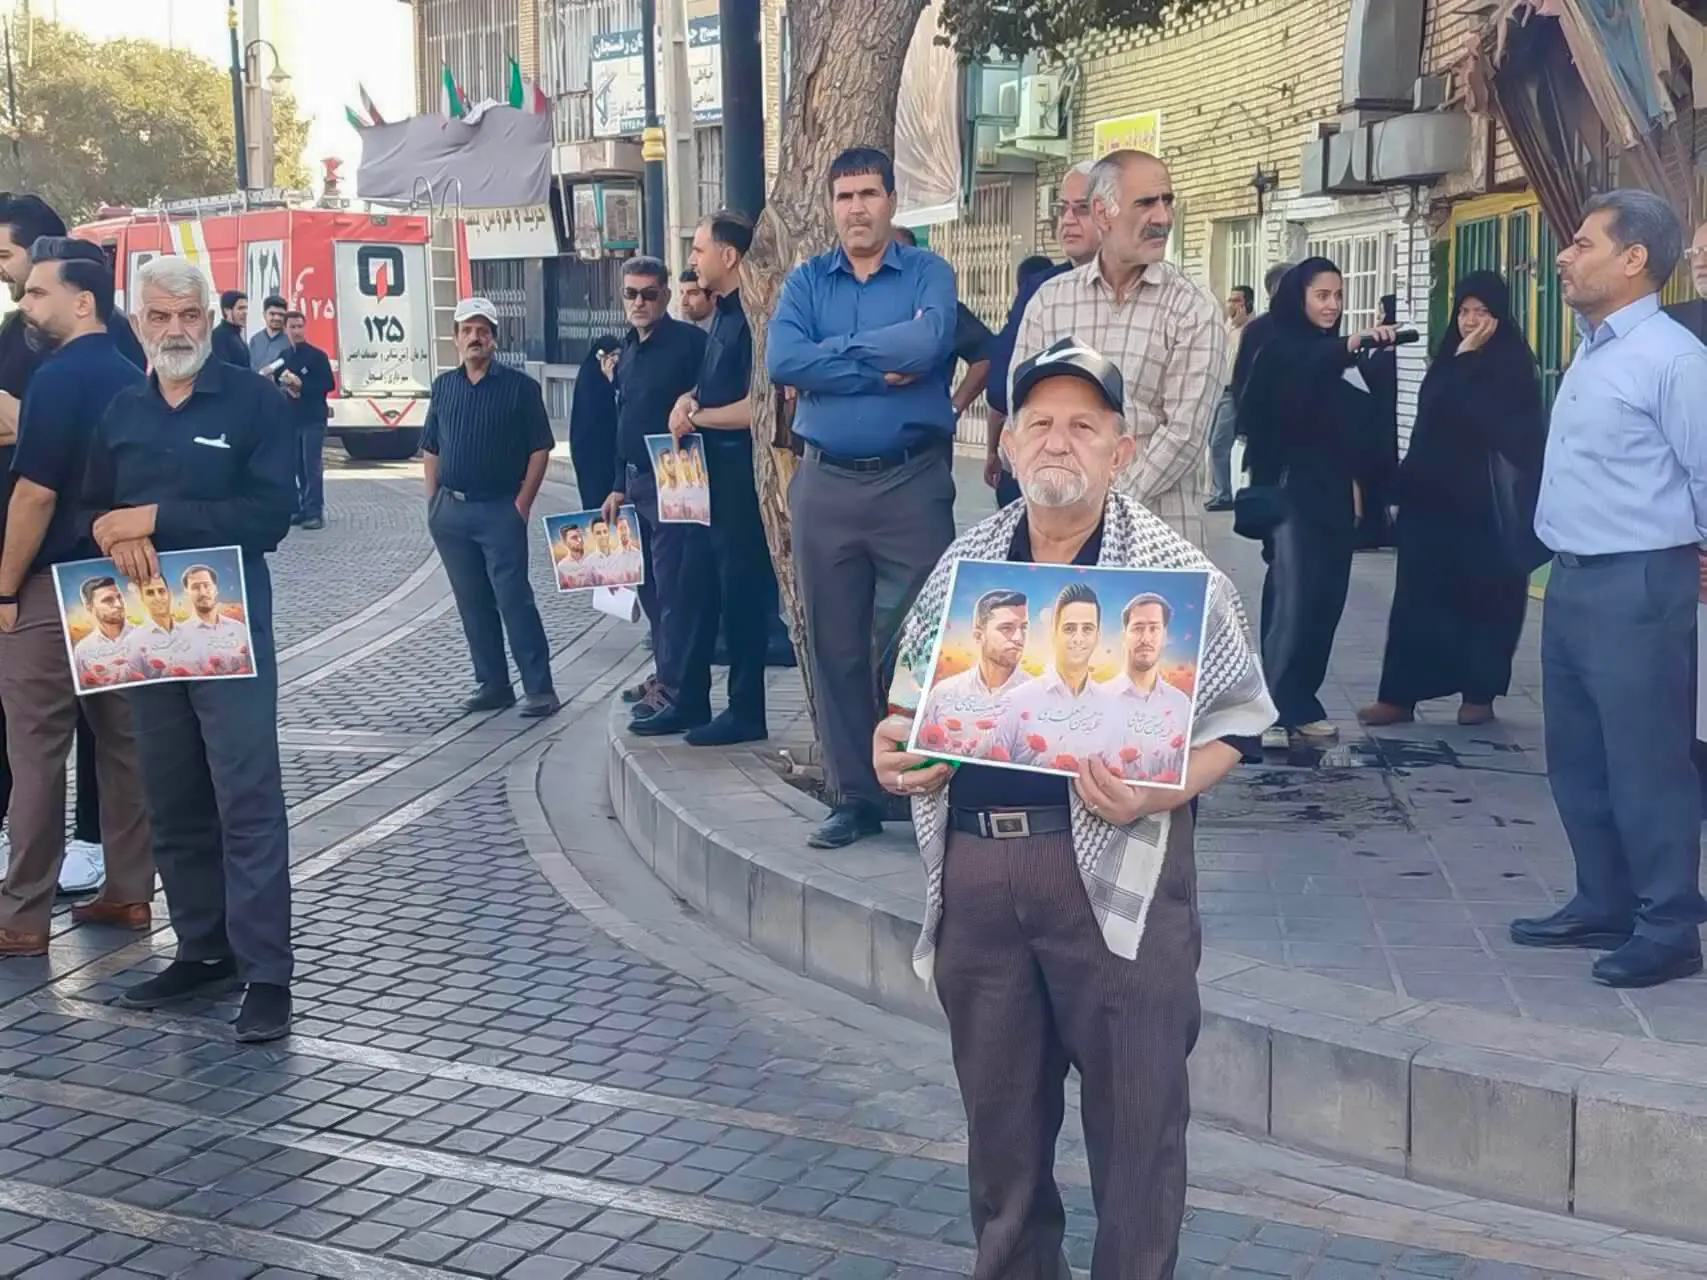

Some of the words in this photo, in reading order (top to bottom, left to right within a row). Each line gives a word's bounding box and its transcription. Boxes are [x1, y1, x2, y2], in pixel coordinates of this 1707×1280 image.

[593, 35, 630, 59] رفسنجان
[482, 208, 512, 233] فروش
[514, 208, 521, 232] و
[524, 207, 546, 232] خرید
[300, 295, 335, 320] ۱۲۵
[363, 315, 405, 343] ۱۲۵
[361, 348, 378, 360] خدمات
[384, 347, 398, 362] نشانی
[399, 346, 409, 362] آتش
[410, 347, 428, 362] سازمان
